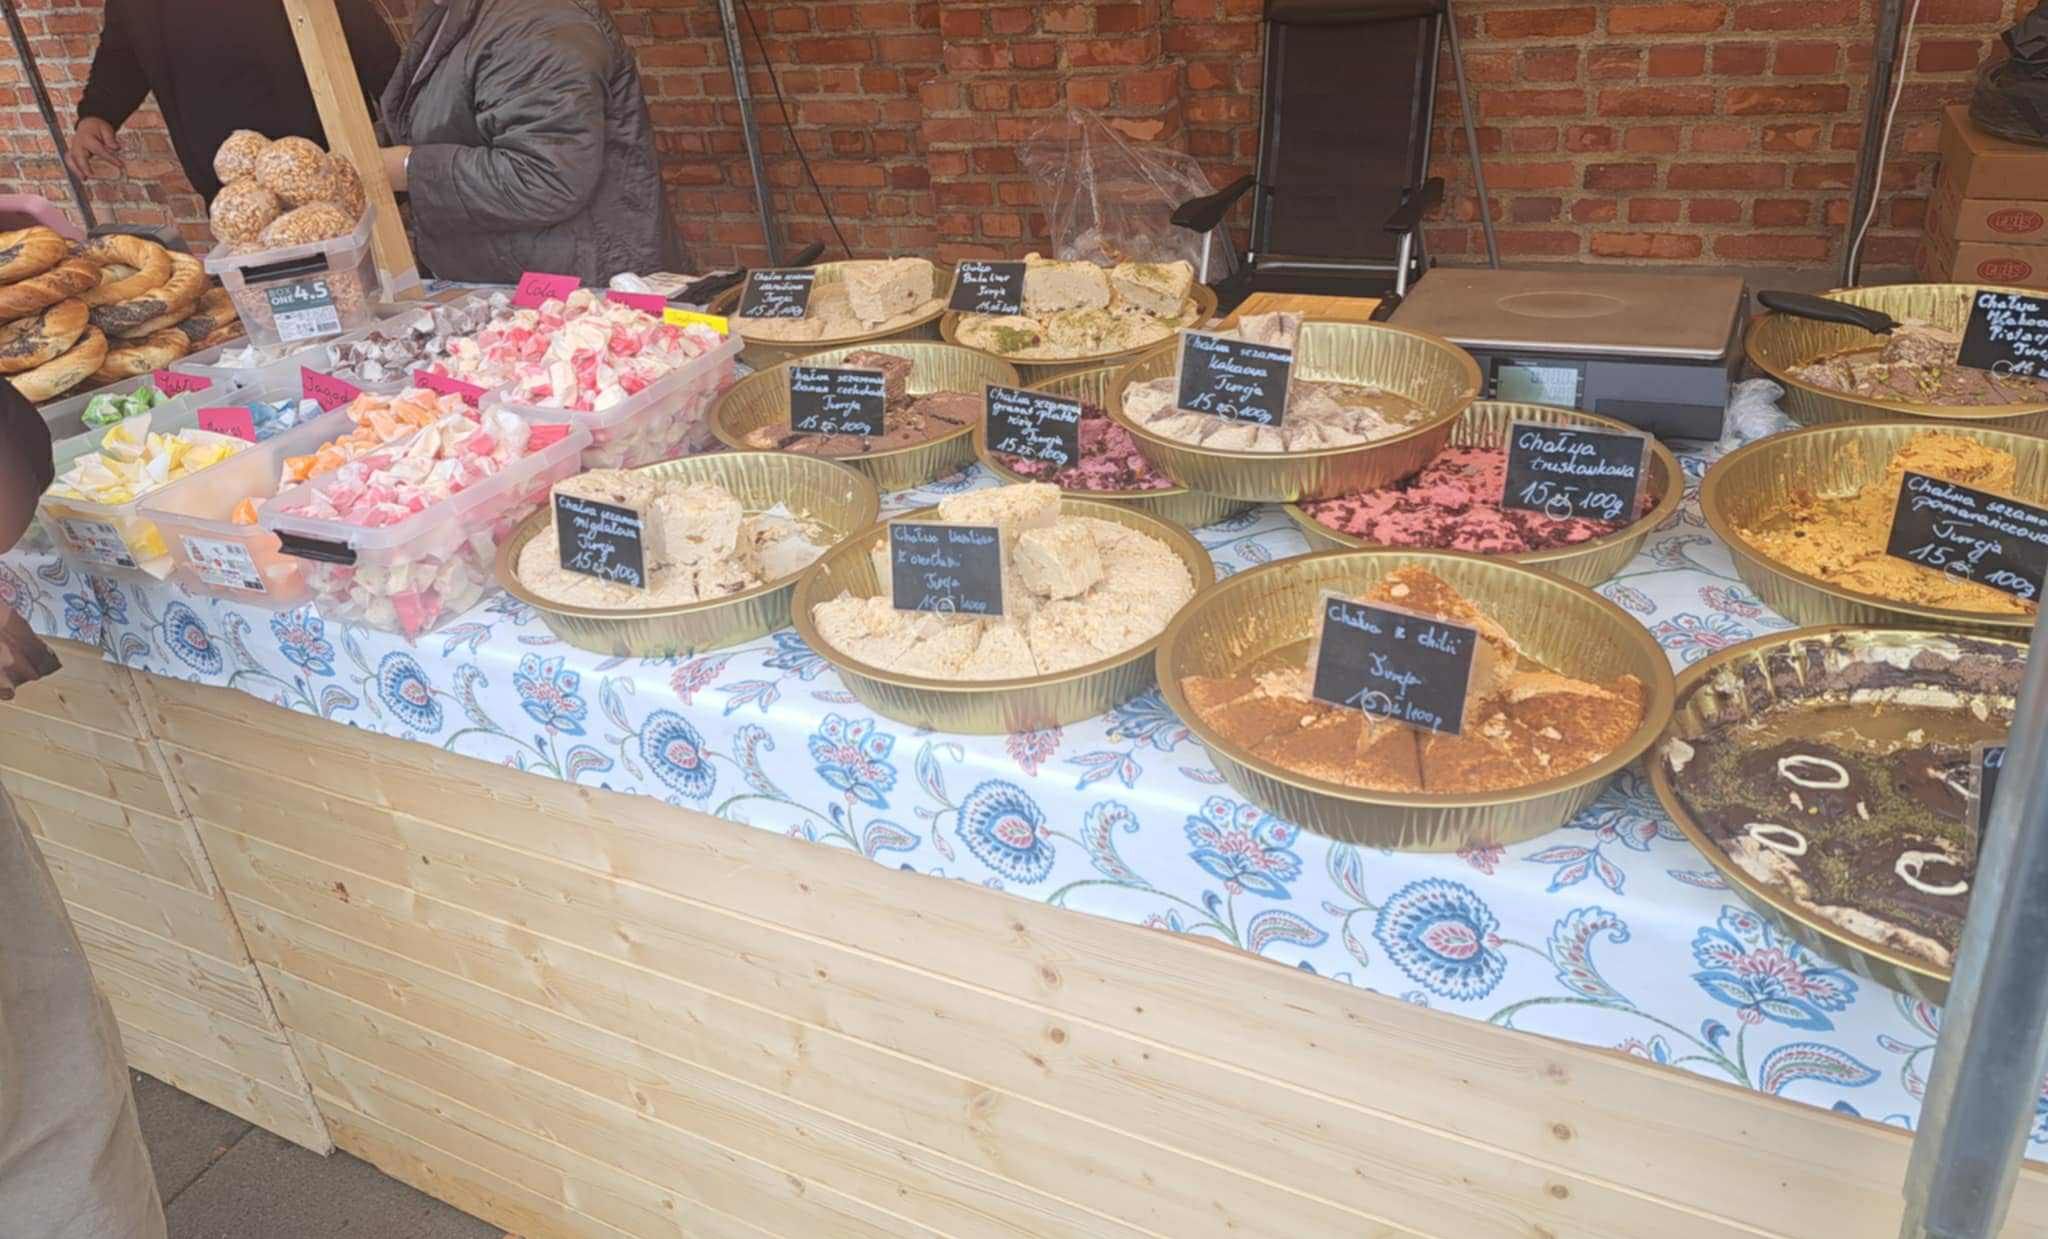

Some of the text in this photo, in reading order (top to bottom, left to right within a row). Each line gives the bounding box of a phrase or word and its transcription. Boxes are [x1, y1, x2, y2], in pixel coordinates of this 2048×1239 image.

[294, 281, 328, 301] 4.5
[526, 279, 558, 298] Cola
[746, 305, 768, 316] 15
[2009, 360, 2035, 375] 15
[1186, 392, 1217, 410] 15
[1239, 405, 1273, 424] 100g
[798, 414, 820, 428] 15
[839, 421, 872, 436] 100g
[996, 437, 1019, 451] 15
[1039, 448, 1069, 465] 100g
[1529, 456, 1636, 478] truskawkowa
[1520, 480, 1556, 505] 15
[1578, 490, 1625, 519] 100g
[1908, 476, 1976, 508] Chałwa
[568, 551, 593, 569] 15
[1908, 543, 1955, 564] 15
[1985, 569, 2036, 598] 100g
[916, 594, 938, 611] 15
[1345, 687, 1378, 710] 15
